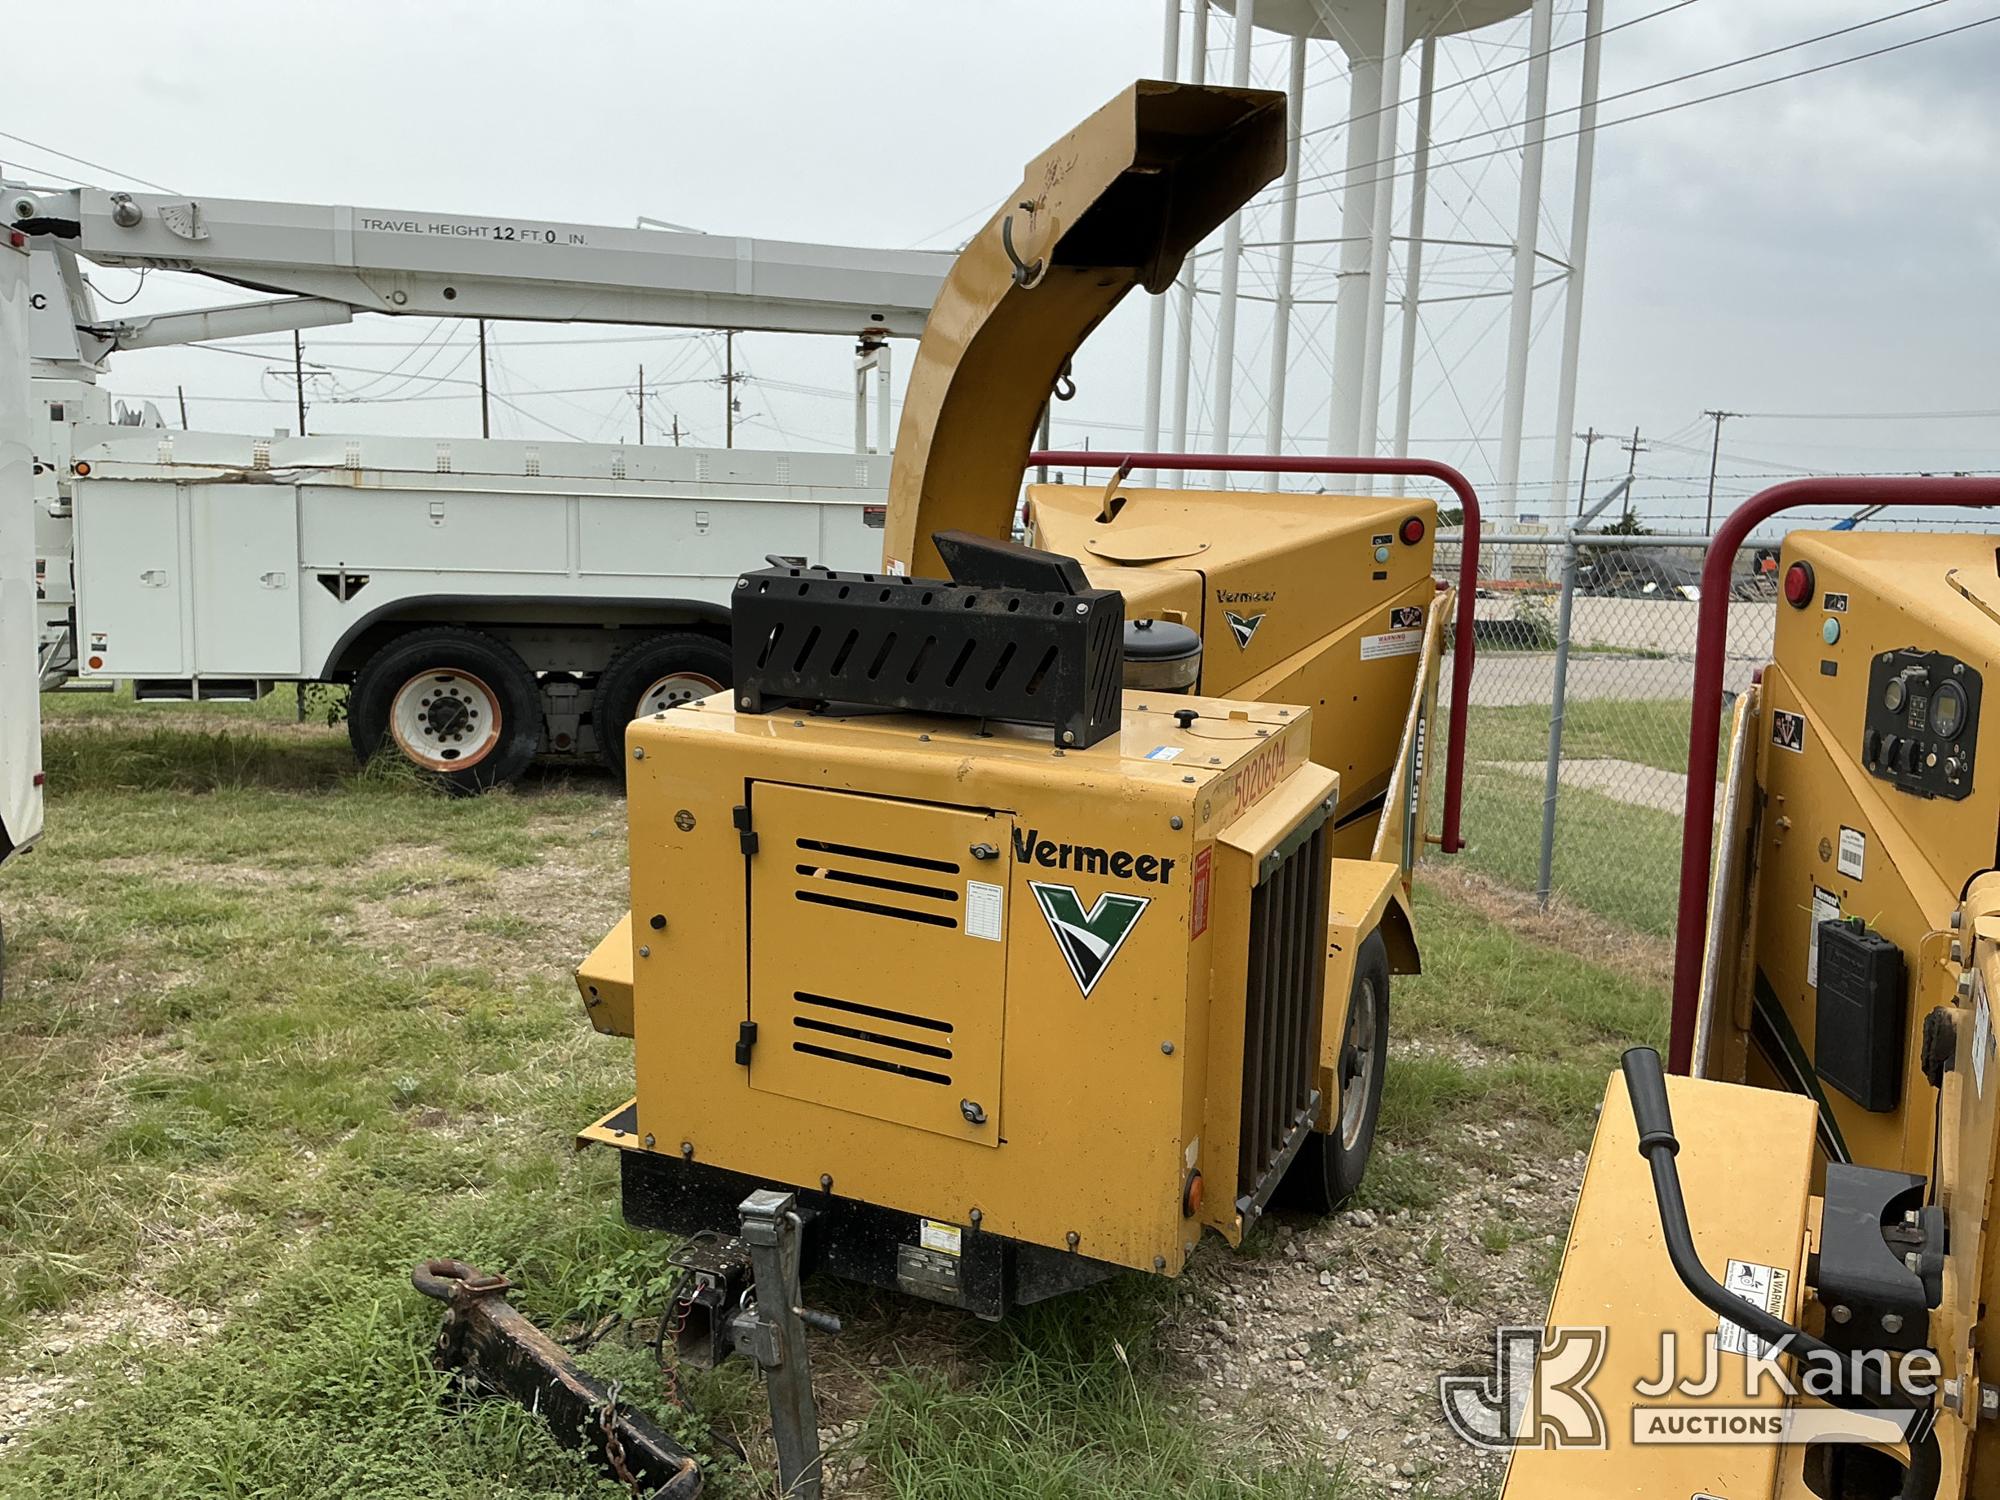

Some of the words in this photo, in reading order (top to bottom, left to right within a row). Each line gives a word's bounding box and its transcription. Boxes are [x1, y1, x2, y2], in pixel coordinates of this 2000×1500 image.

[361, 218, 424, 233] TRAVEL
[428, 223, 489, 238] HEIGHT
[493, 226, 515, 241] 12
[520, 230, 543, 242] FT.
[545, 230, 556, 244] 0
[568, 233, 588, 245] IN.
[1216, 589, 1276, 603] Vermeer
[1233, 736, 1287, 815] 5020604
[1013, 827, 1176, 884] Vermeer
[1769, 1280, 1785, 1318] WARNIN
